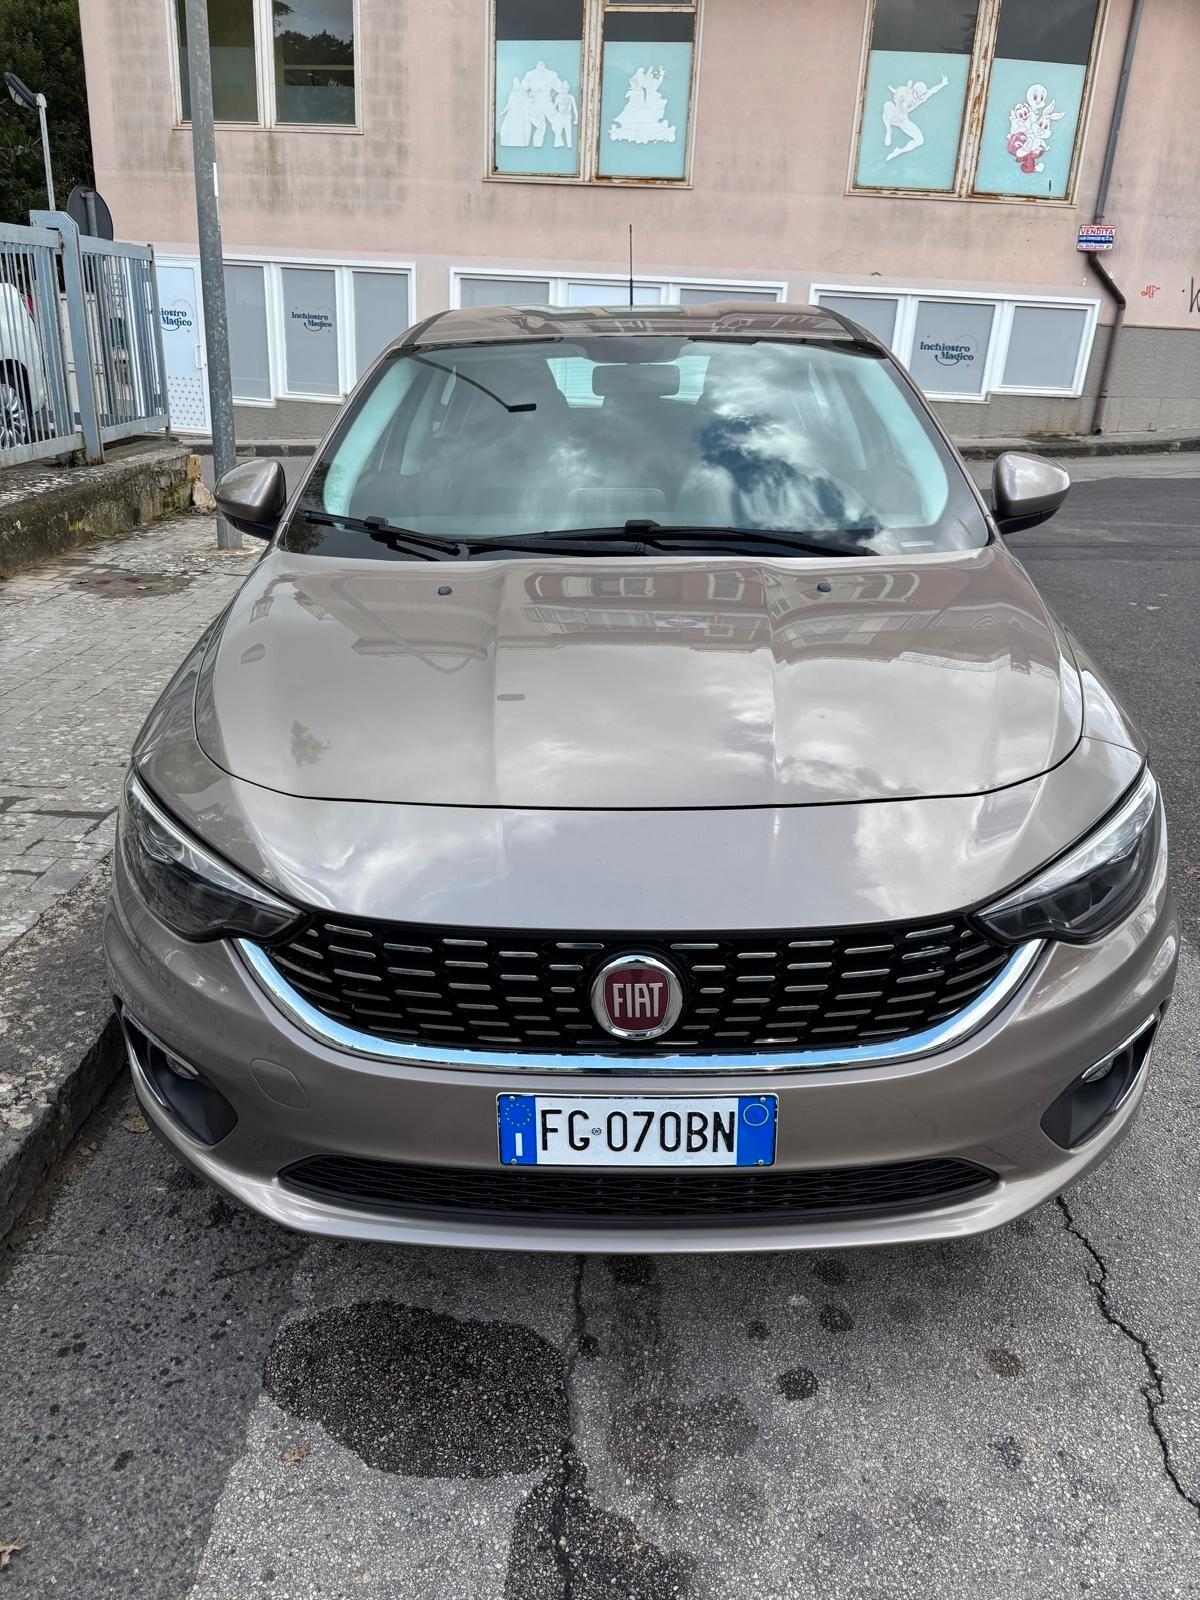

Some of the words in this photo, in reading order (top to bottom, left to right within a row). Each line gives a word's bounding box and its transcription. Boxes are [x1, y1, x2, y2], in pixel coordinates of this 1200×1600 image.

[1080, 228, 1114, 236] VENDITA
[160, 307, 187, 317] iostro
[291, 311, 329, 321] Inchiostro
[161, 315, 192, 329] Magico
[306, 319, 333, 330] Magico
[919, 341, 971, 353] Inchiostro
[937, 351, 974, 365] Magico
[612, 982, 664, 1018] FIAT
